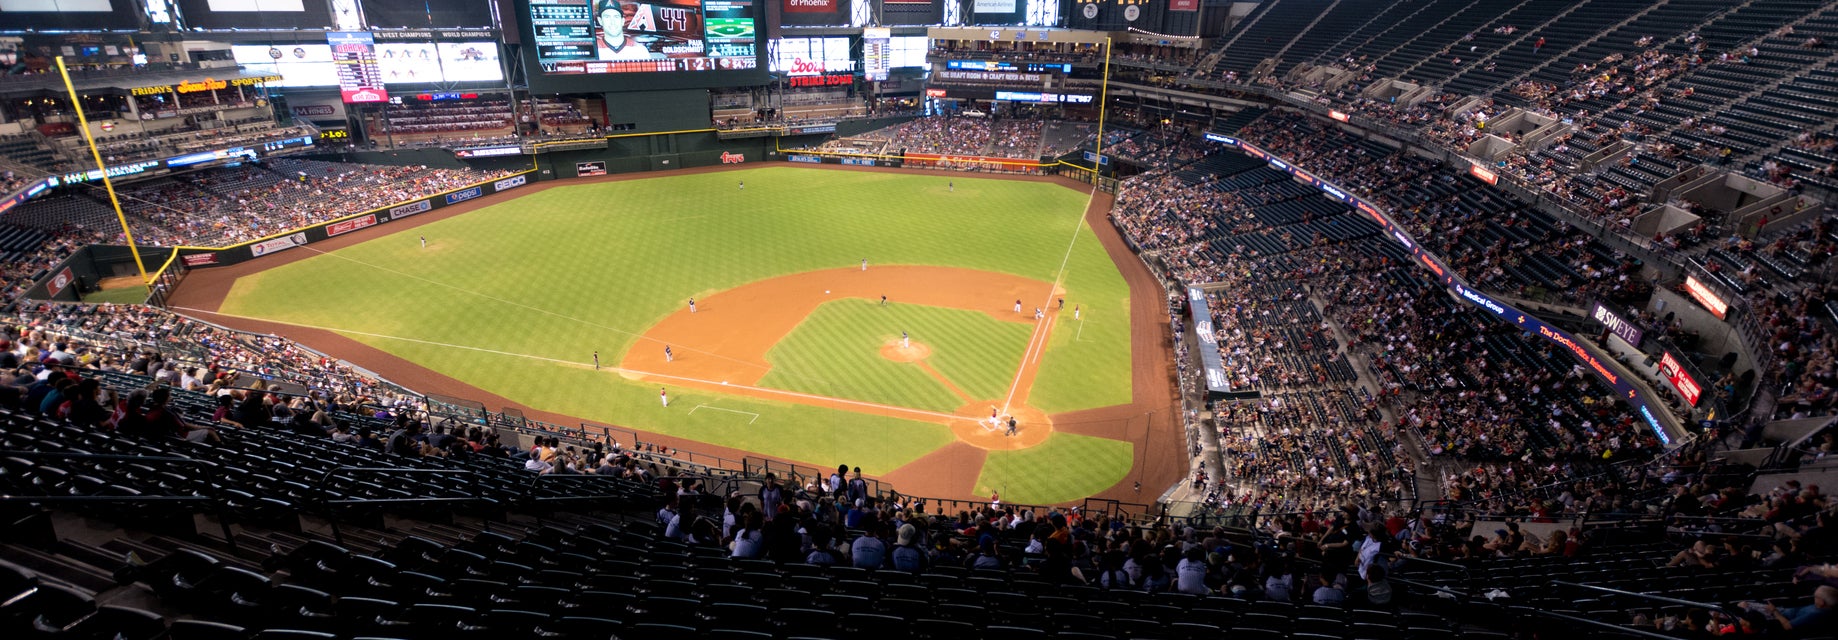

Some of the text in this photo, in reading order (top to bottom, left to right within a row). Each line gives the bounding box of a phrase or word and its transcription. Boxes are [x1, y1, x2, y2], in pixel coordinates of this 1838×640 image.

[661, 8, 686, 31] 44
[990, 30, 1000, 39] 42
[662, 45, 704, 53] GOLDSCHMIDT
[683, 57, 715, 70] 1 2 1
[790, 57, 824, 73] Coors
[231, 77, 263, 87] SPORTS
[790, 74, 853, 87] STRIKE ZONE
[953, 157, 1003, 169] State Farm
[497, 177, 524, 189] GEICO
[458, 188, 477, 201] pepsi
[394, 203, 420, 217] CHASE
[266, 240, 285, 248] TOTAL
[1463, 289, 1486, 305] Medical
[1485, 299, 1504, 314] Group
[1540, 325, 1553, 338] The
